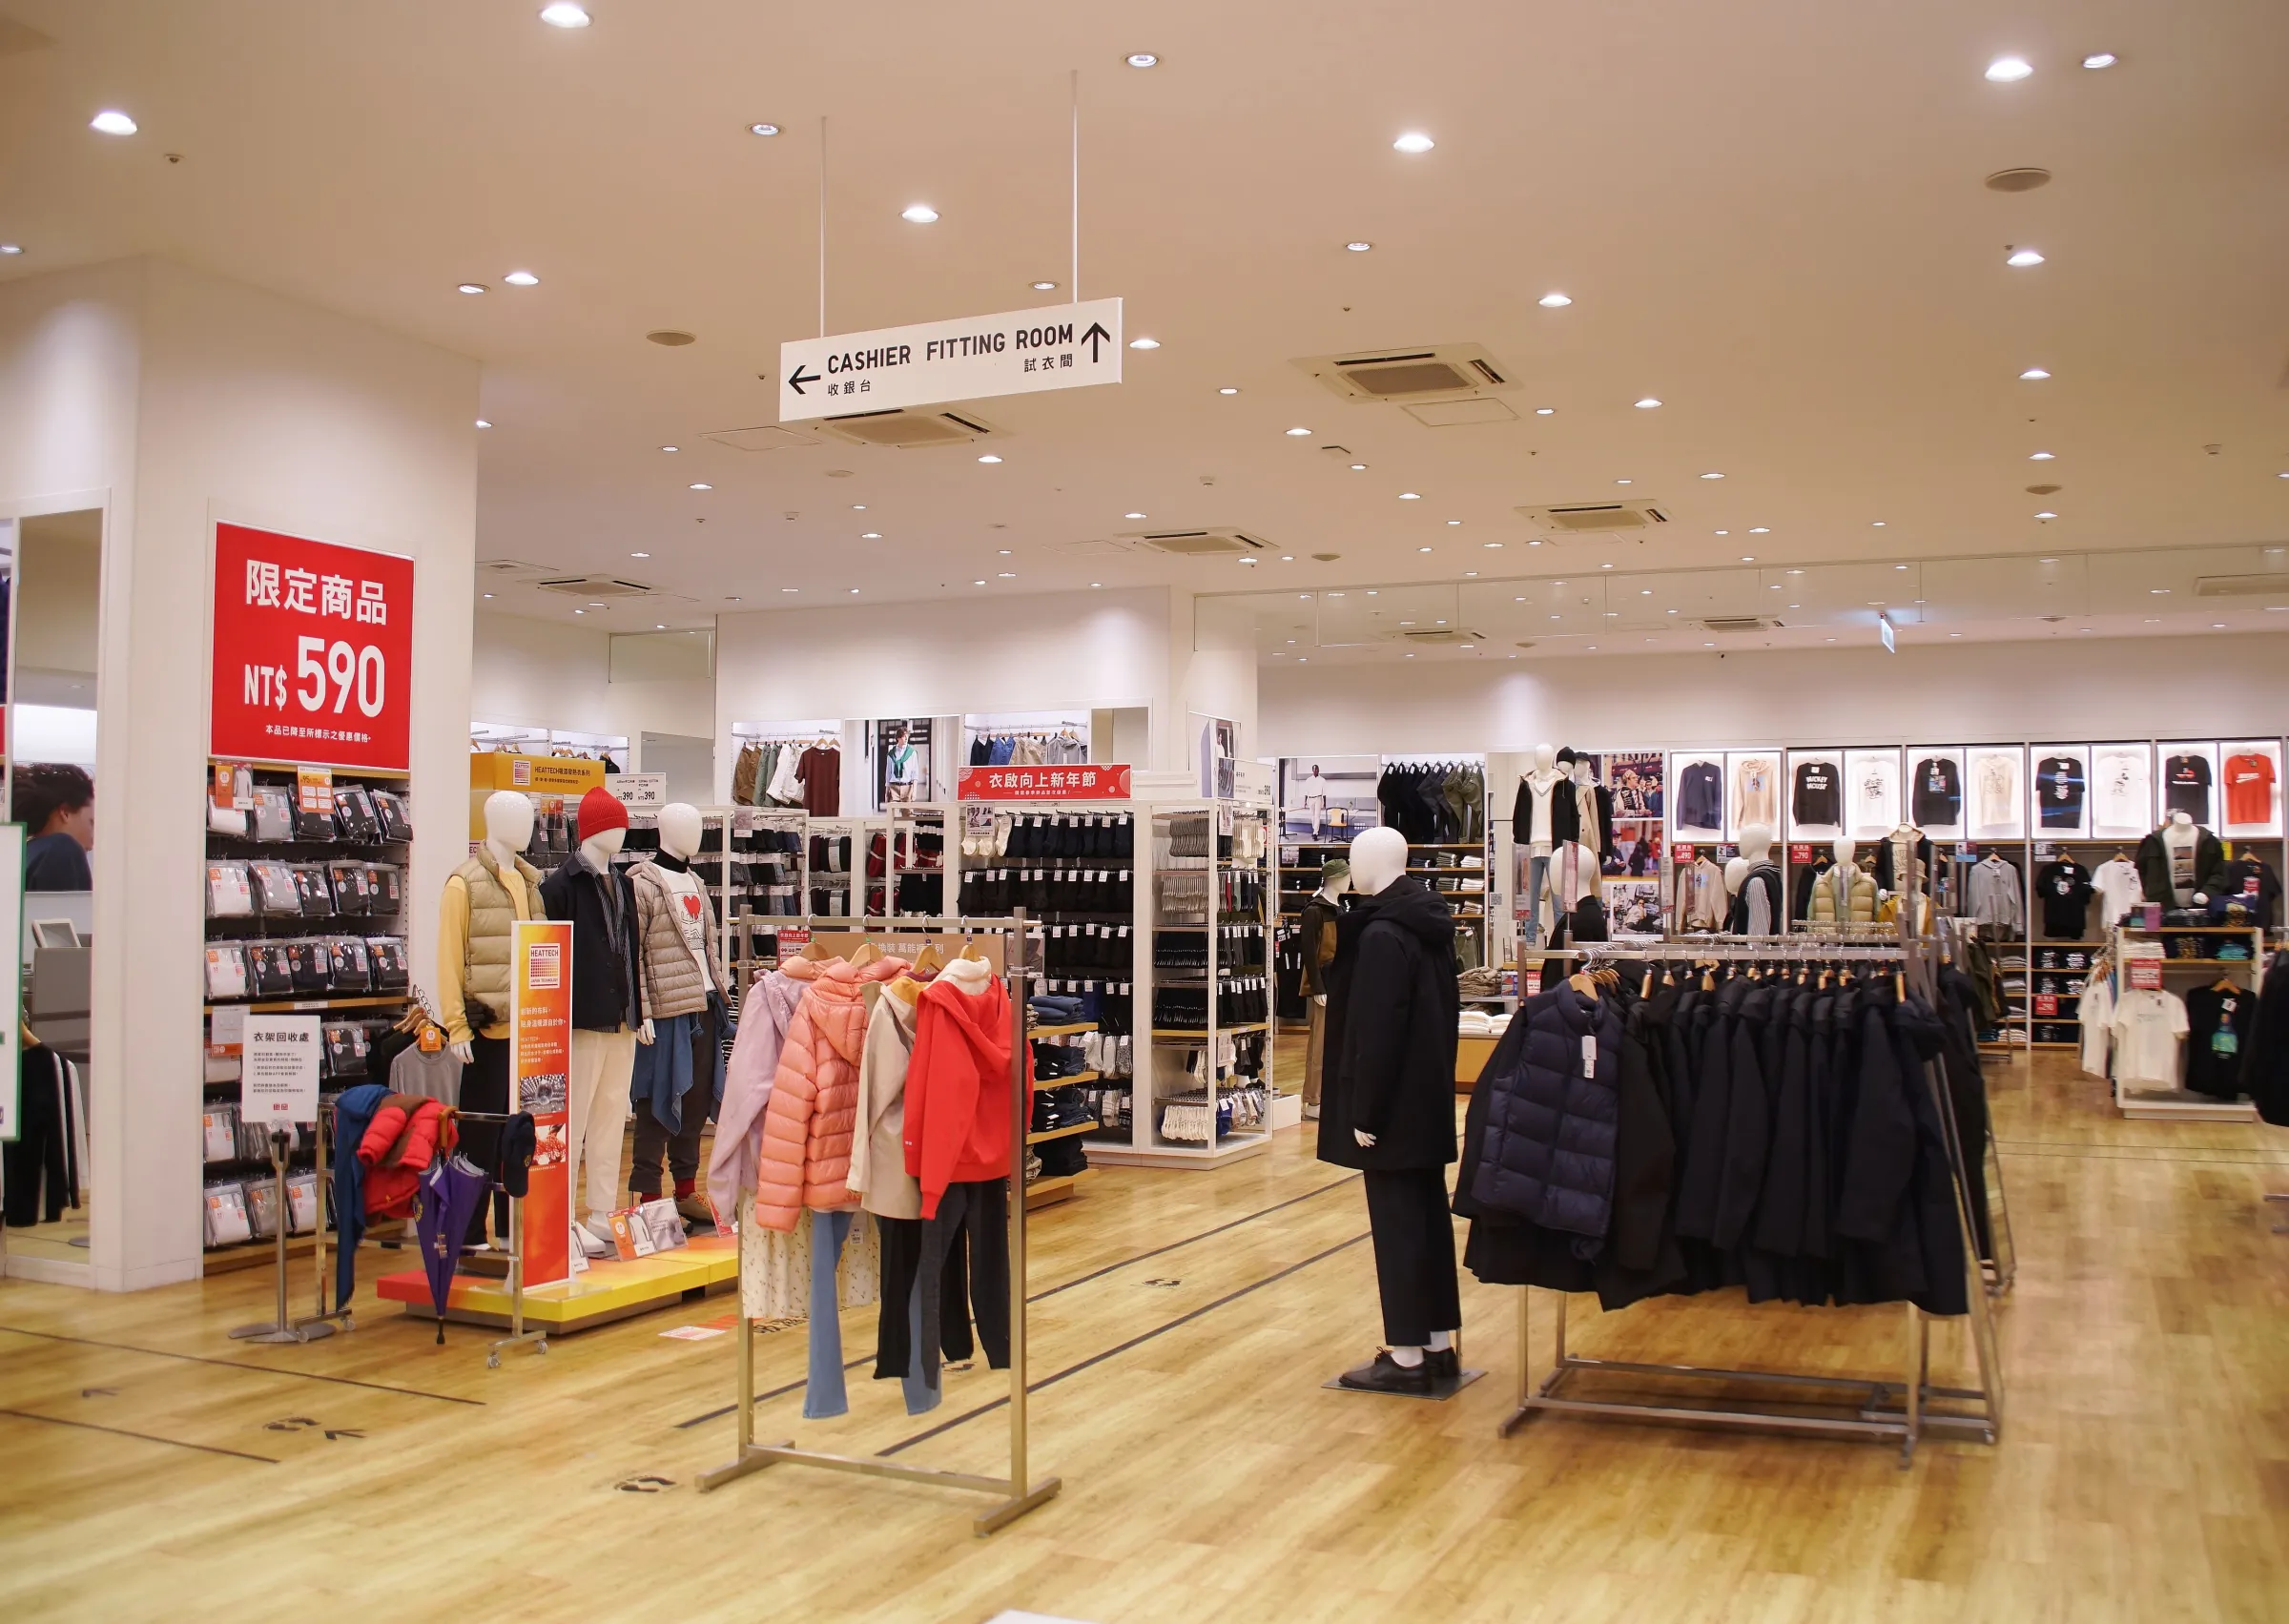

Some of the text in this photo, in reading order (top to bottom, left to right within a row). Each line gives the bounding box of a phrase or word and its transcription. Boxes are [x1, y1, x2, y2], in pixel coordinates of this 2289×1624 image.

[828, 323, 1073, 374] CASHIER FITTING ROOM
[1024, 354, 1073, 373] 試衣間
[828, 380, 872, 397] 收銀台
[245, 559, 387, 626] 限定商品
[244, 635, 385, 718] NT$ 590
[989, 771, 1096, 788] 衣啟向上新年節
[623, 791, 633, 801] 390
[644, 791, 655, 800] 390
[530, 949, 559, 957] HEATTECH
[254, 1032, 310, 1042] 衣架回收處
